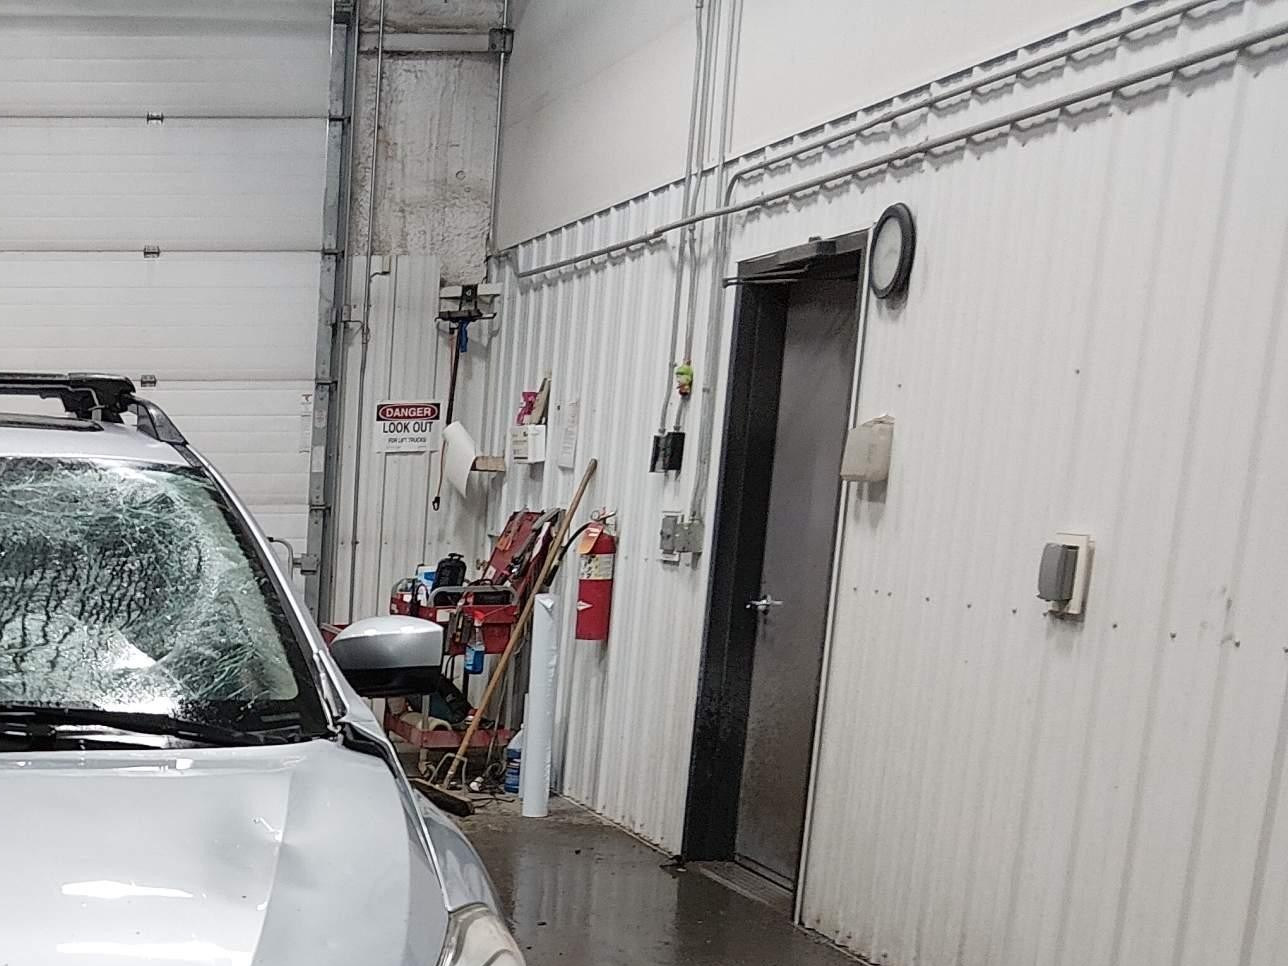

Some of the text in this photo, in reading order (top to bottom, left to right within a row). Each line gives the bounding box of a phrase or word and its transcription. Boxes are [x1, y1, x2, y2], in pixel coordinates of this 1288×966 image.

[385, 407, 432, 418] DANGER
[382, 421, 433, 434] LOOK OUT
